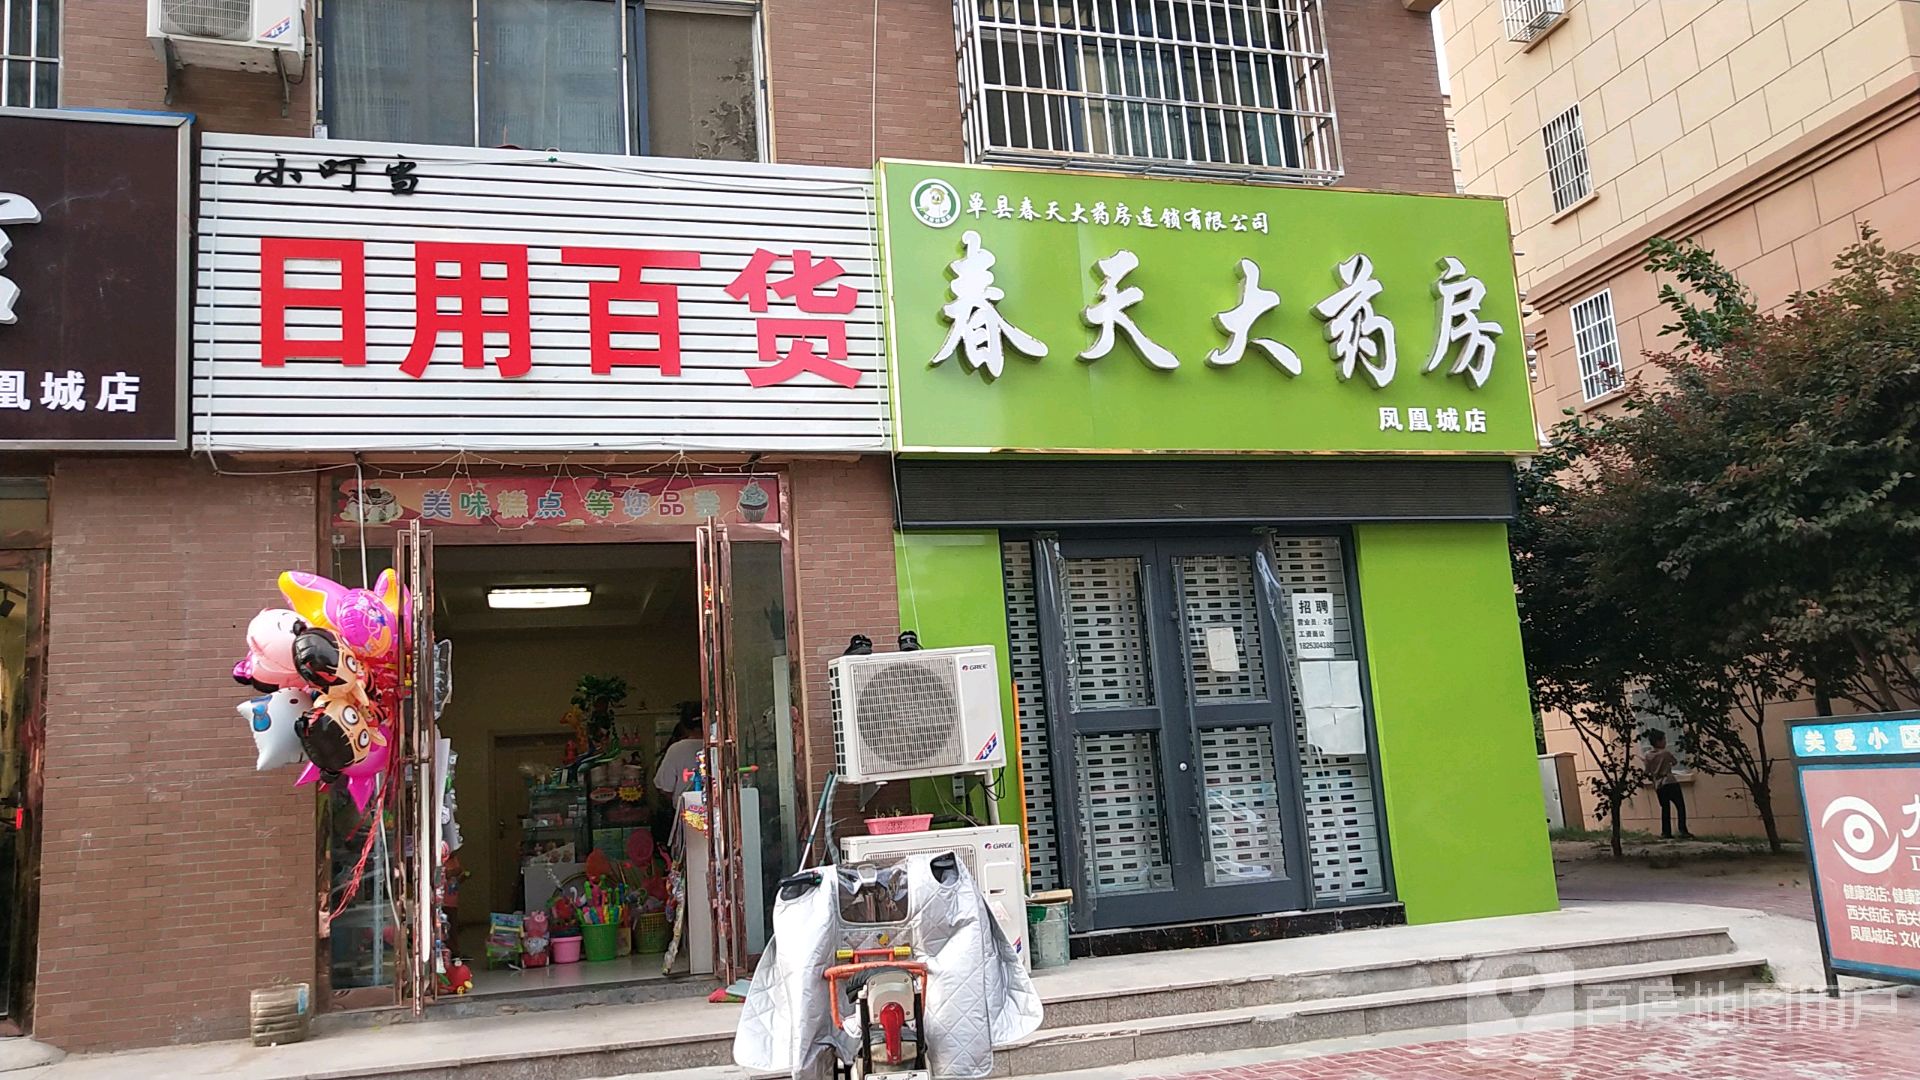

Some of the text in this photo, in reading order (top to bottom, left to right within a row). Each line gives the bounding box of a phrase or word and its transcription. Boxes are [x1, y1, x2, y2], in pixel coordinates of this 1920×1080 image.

[966, 192, 1270, 234] 单县春天大药房连锁有限公司
[261, 238, 862, 390] 日用百货
[930, 231, 1503, 389] 春天大药房
[1378, 406, 1488, 434] 凤凰城店
[1298, 599, 1329, 614] 招聘
